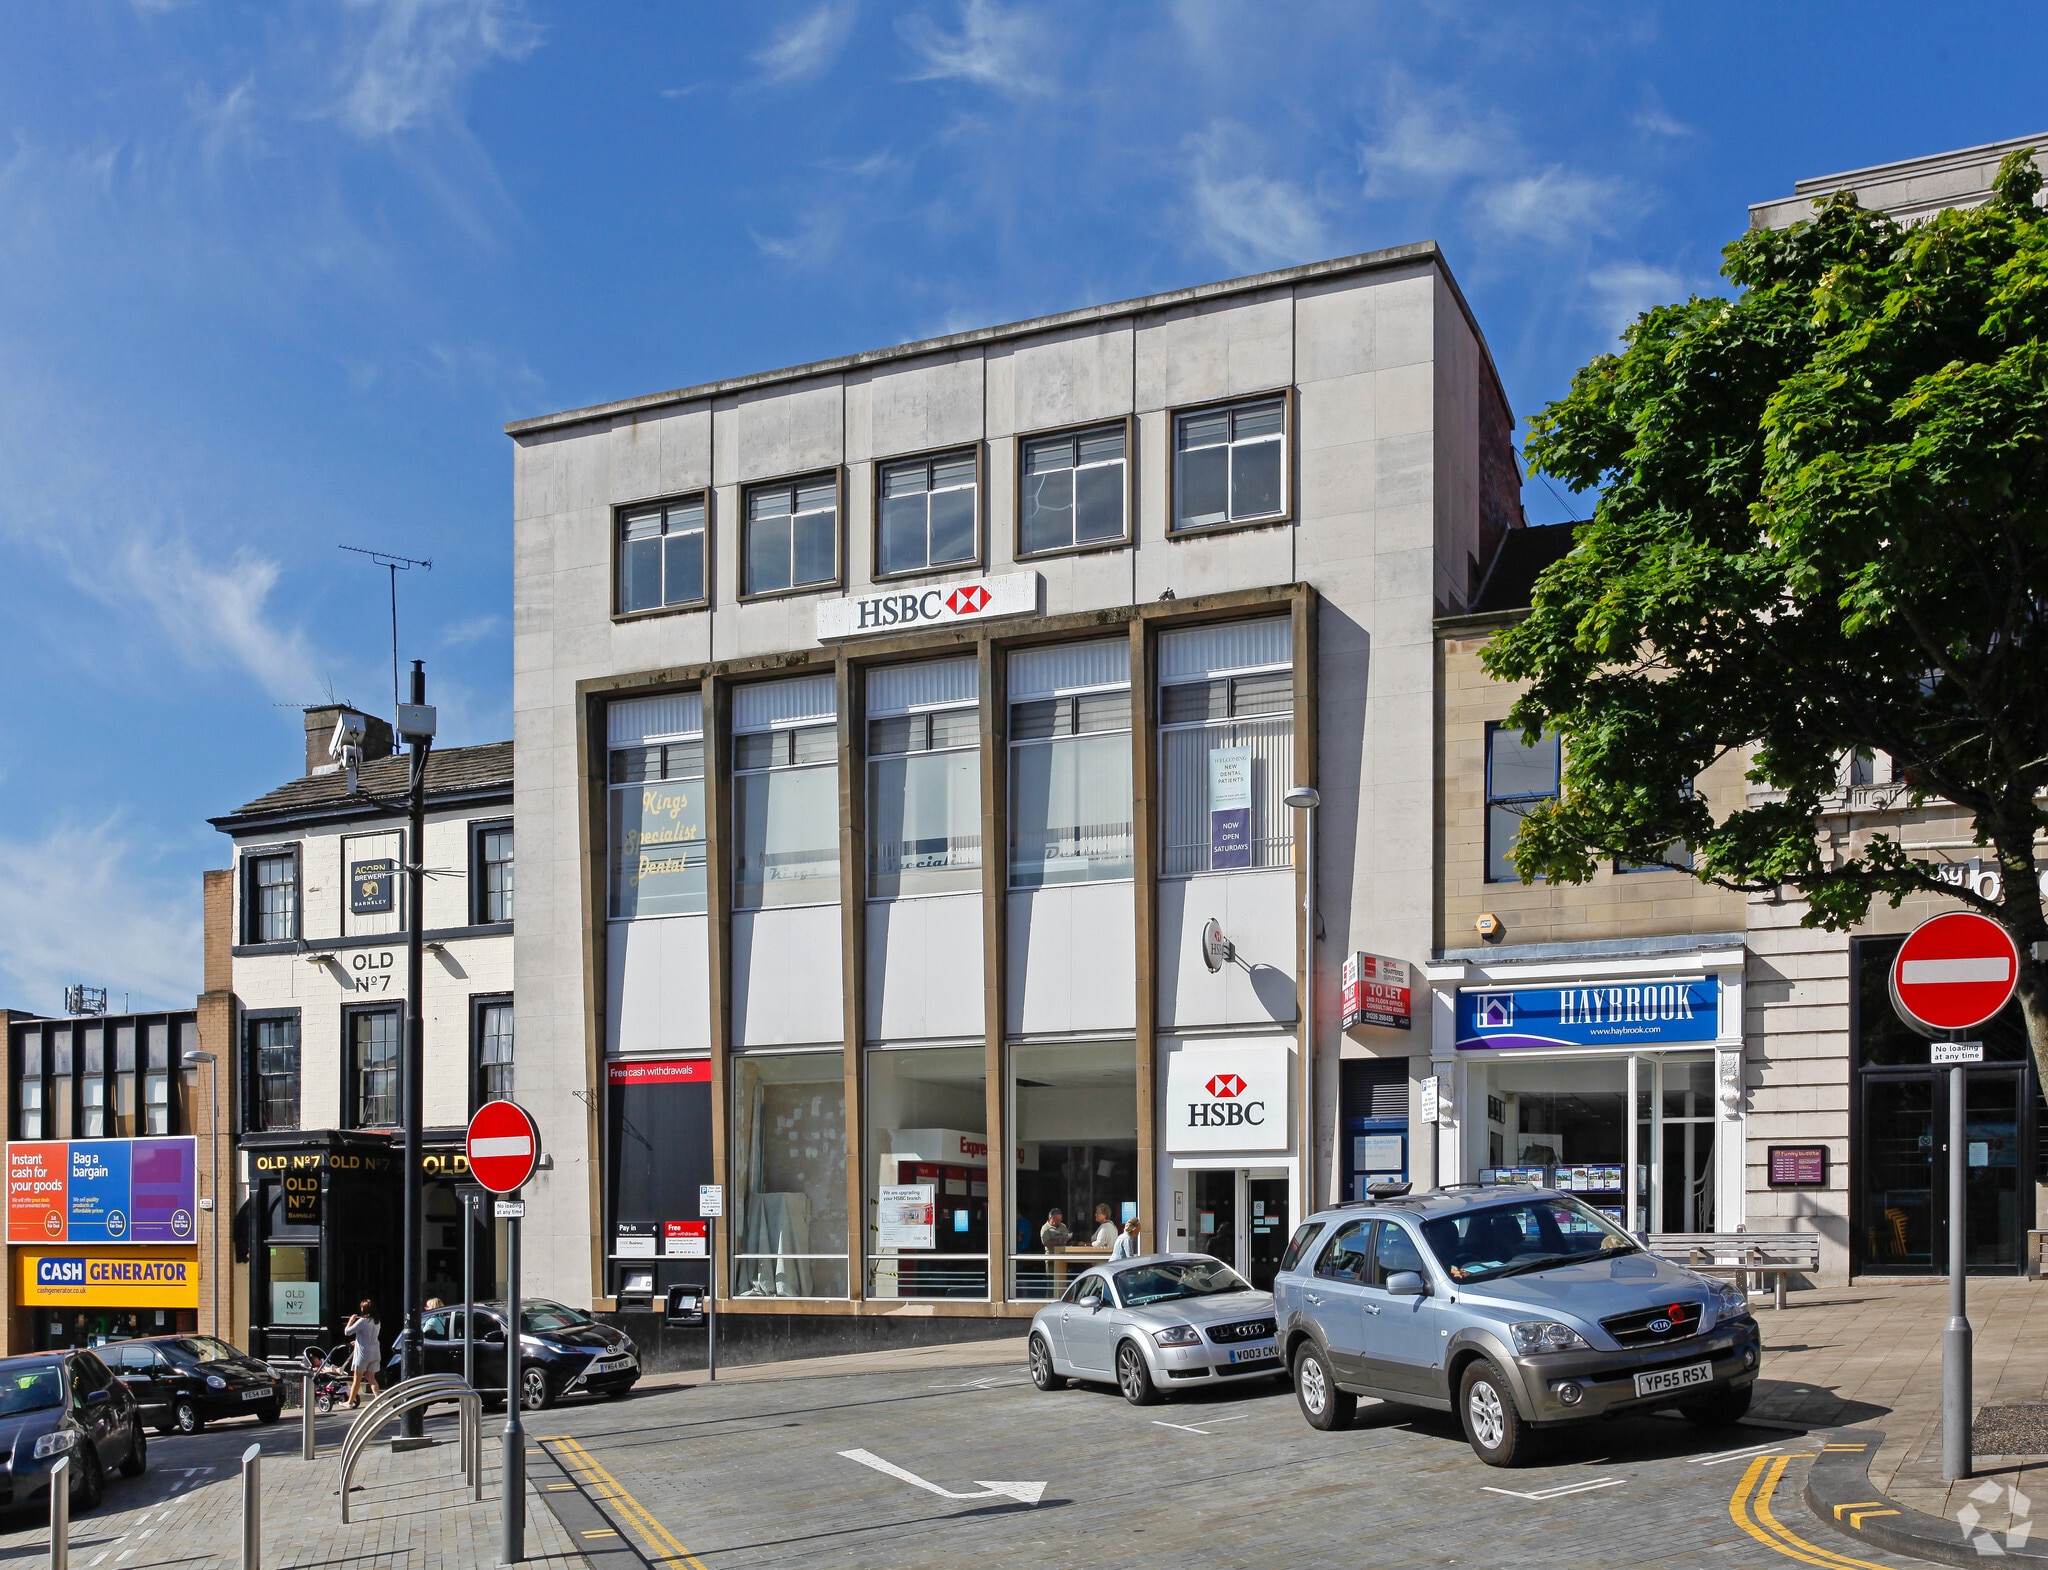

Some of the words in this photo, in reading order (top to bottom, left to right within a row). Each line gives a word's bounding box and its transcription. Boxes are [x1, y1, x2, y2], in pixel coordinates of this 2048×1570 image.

[857, 590, 942, 629] HSBC
[643, 791, 688, 819] Kings
[1222, 822, 1239, 830] NOW
[623, 821, 697, 856] Specialist
[1222, 833, 1240, 841] OPEN
[1213, 844, 1249, 853] SATURDAYS
[629, 852, 687, 888] Dental
[354, 872, 386, 881] BREWERY
[354, 899, 387, 907] BARNSLEY
[352, 951, 394, 971] OLD
[1383, 967, 1404, 977] CHARTERED
[1370, 984, 1383, 996] TO
[1385, 985, 1402, 1000] LET
[1366, 1003, 1392, 1012] CONSULTING
[1393, 1006, 1405, 1014] ROOM
[1375, 997, 1389, 1005] FLOOR
[1389, 1000, 1403, 1008] OFFICE
[1558, 984, 1695, 1025] HAYBROOK
[1590, 1026, 1661, 1036] www.haybrook.com
[1949, 1044, 1979, 1052] loading
[610, 1068, 628, 1077] Free
[628, 1066, 646, 1077] cash
[647, 1065, 693, 1076] withdrawals
[1187, 1100, 1265, 1127] HSBC
[11, 1153, 43, 1165] Instant
[73, 1152, 92, 1167] Bag
[92, 1154, 99, 1164] a
[257, 1156, 287, 1171] OLD
[330, 1155, 360, 1169] OLD
[422, 1155, 469, 1175] OLD
[11, 1166, 32, 1178] cash
[34, 1166, 48, 1178] for
[72, 1165, 109, 1180] bargain
[11, 1181, 32, 1194] your
[33, 1179, 63, 1194] goods
[285, 1177, 318, 1191] OLD
[619, 1224, 630, 1232] Pay
[40, 1262, 83, 1281] CASH
[89, 1263, 187, 1281] GENERATOR
[36, 1286, 87, 1295] cashgenerator.co.uk
[285, 1289, 305, 1299] OLD
[1653, 1321, 1669, 1330] KIA
[1645, 1371, 1680, 1391] YP55
[1683, 1366, 1708, 1384] RSX
[244, 1390, 260, 1399] YE54
